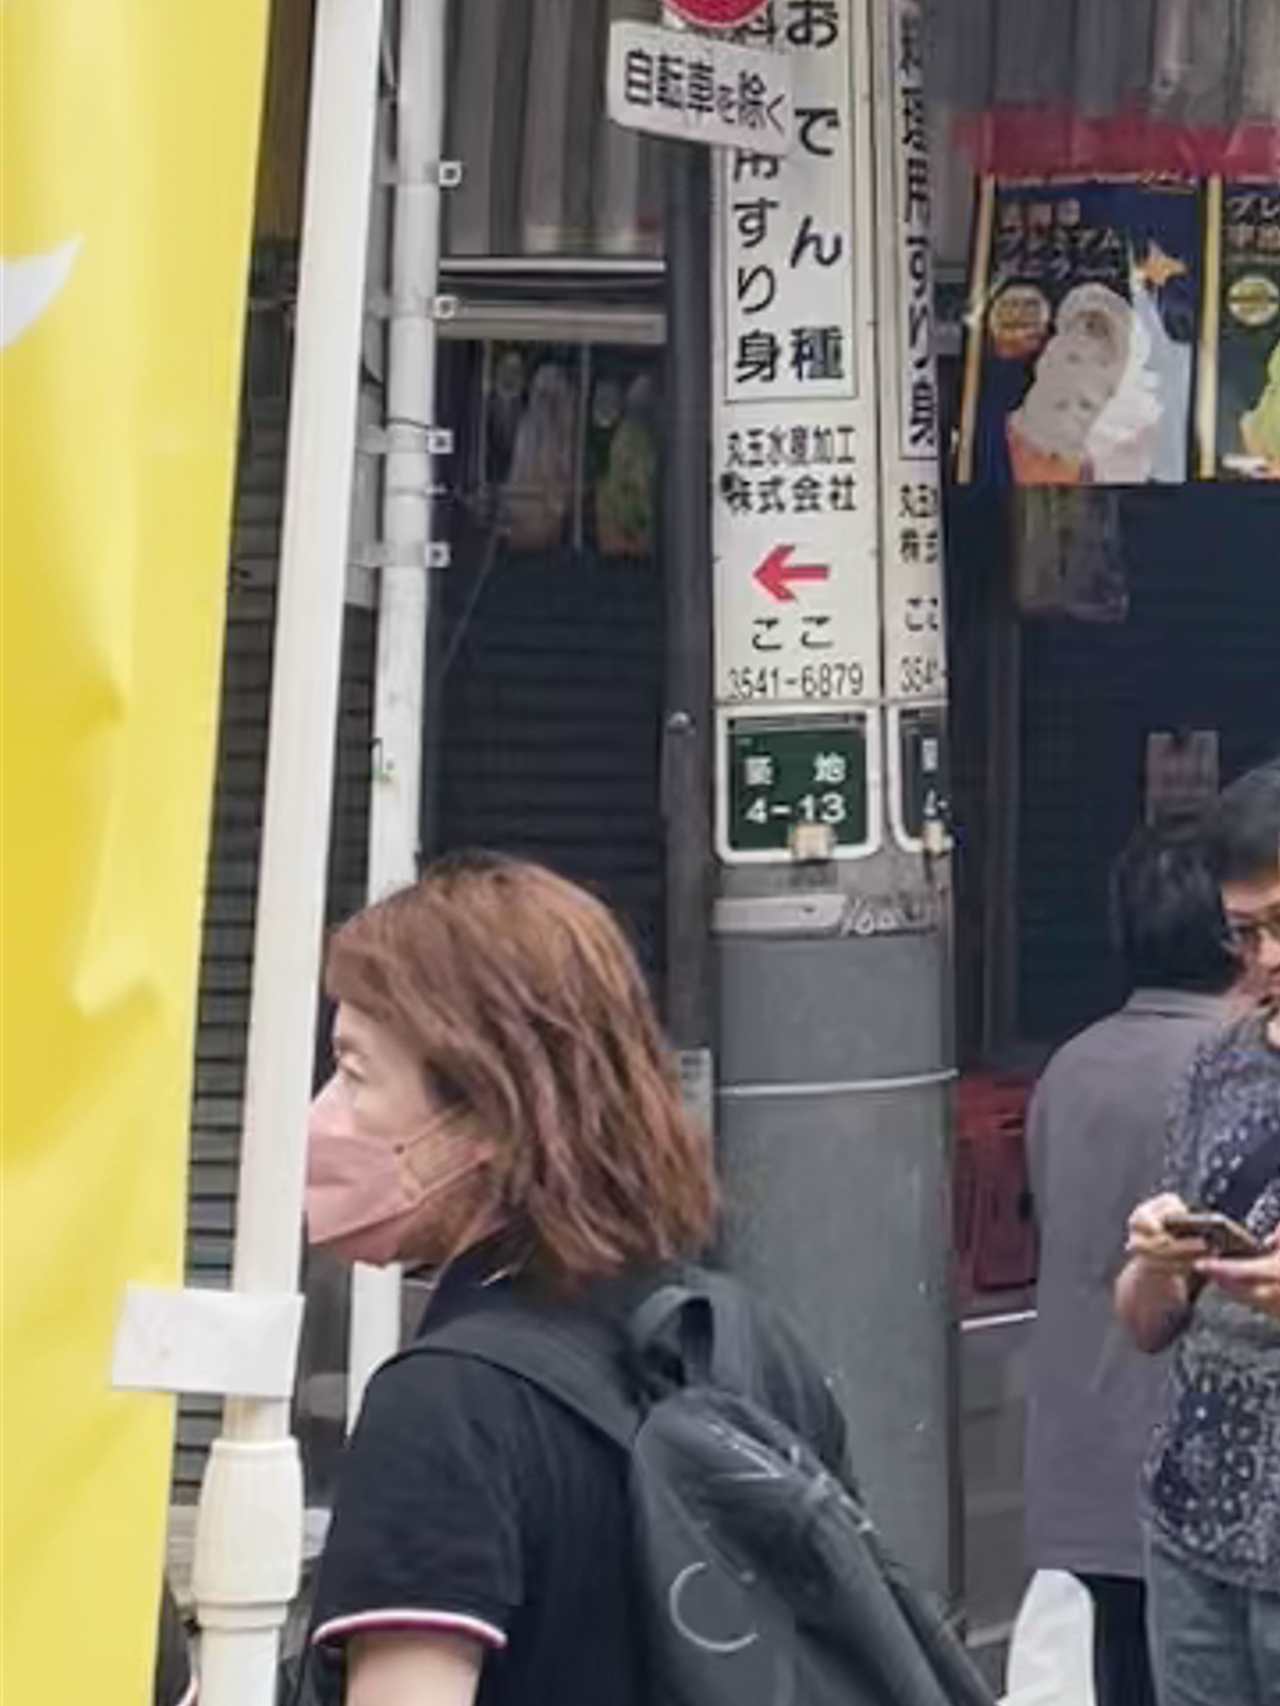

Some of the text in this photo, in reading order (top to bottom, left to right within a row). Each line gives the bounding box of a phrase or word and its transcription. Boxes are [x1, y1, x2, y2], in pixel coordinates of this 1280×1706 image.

[624, 46, 787, 136] 自転車を除く
[721, 472, 858, 515] 株式会社
[750, 616, 836, 652] ここ
[726, 662, 864, 700] 3541-6879
[744, 792, 847, 825] 4-13
